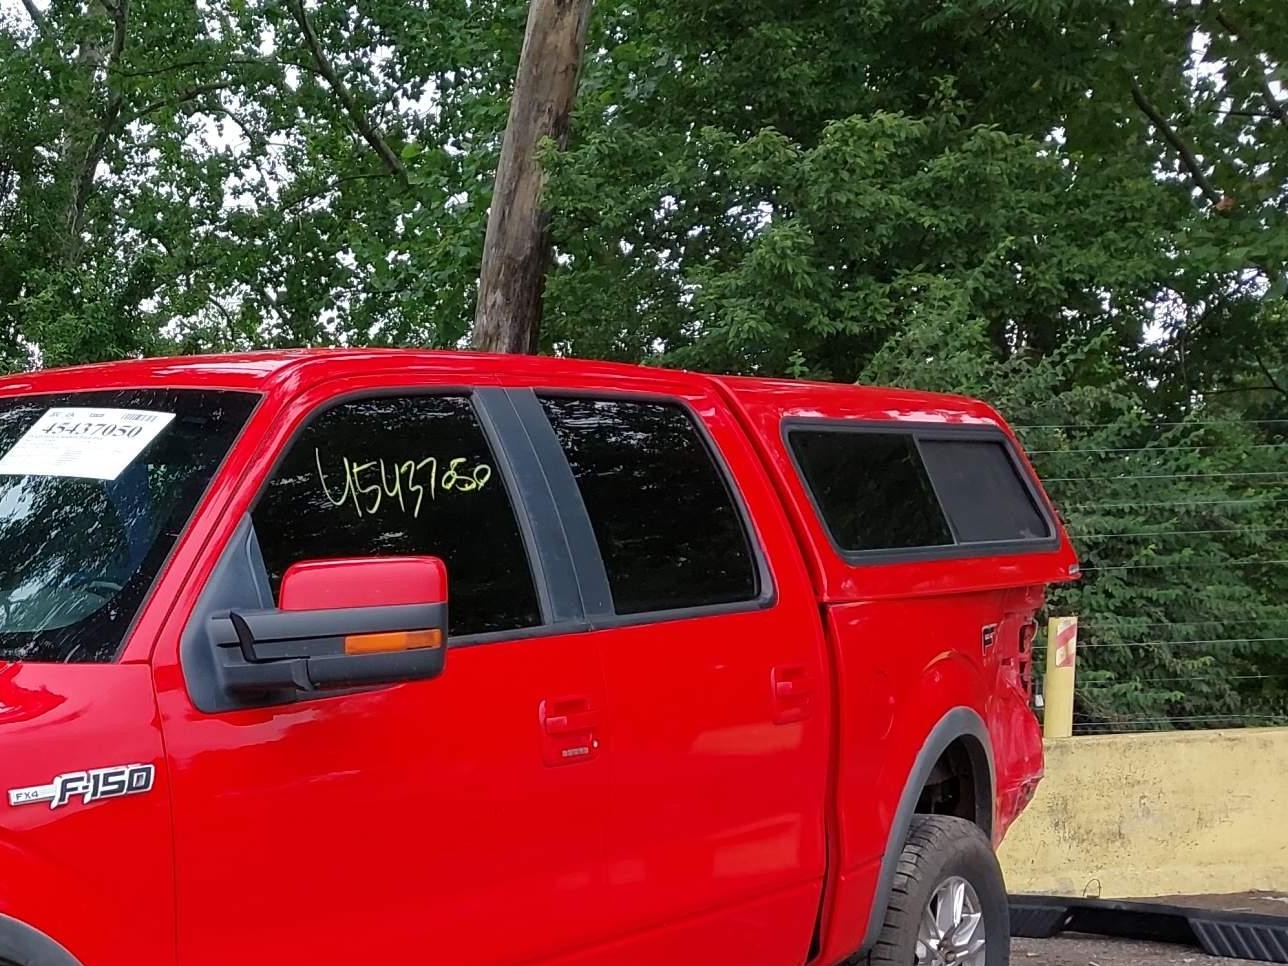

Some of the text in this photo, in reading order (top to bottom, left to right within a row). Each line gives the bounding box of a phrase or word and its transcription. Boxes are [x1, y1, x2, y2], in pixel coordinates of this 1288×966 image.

[42, 422, 143, 438] 45437050
[16, 764, 155, 807] FX4 F-150
